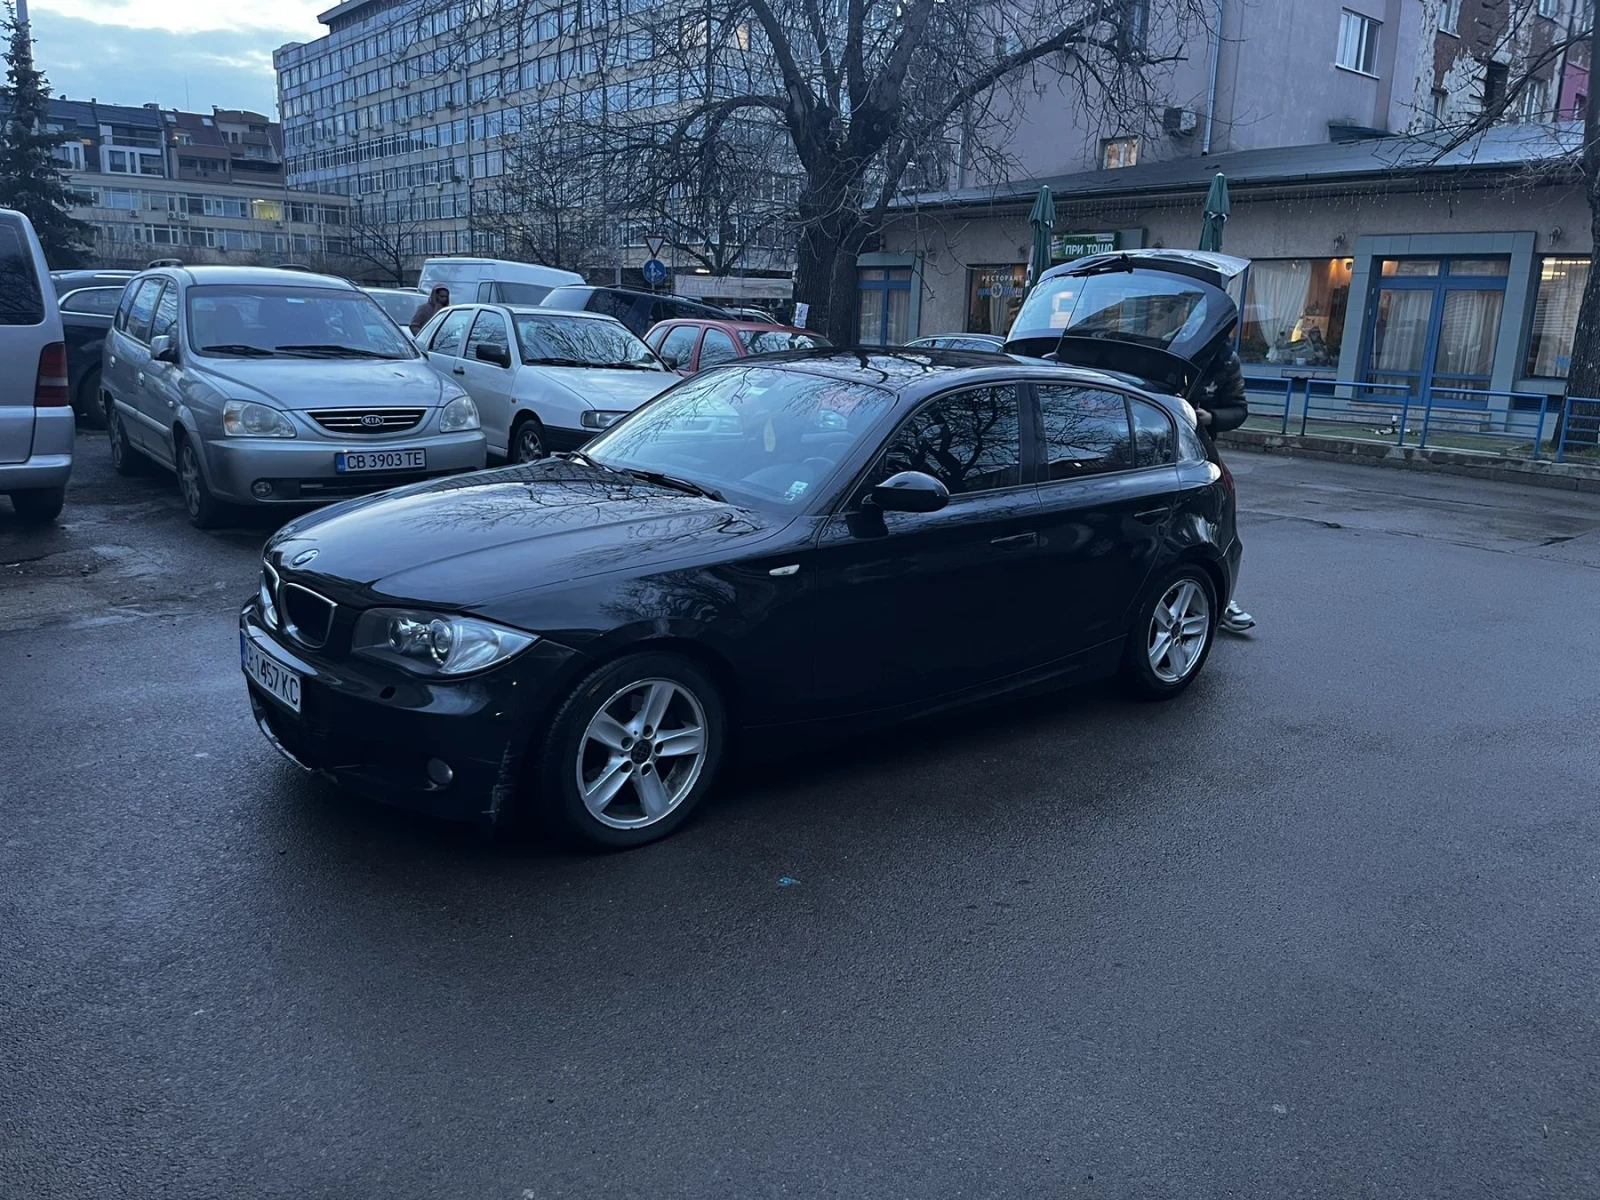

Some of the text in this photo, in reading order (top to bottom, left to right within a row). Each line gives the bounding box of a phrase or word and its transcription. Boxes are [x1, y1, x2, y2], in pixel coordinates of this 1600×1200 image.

[1065, 244, 1083, 255] ПРИ
[1086, 243, 1113, 254] ТОШО
[347, 455, 366, 469] CB
[369, 453, 403, 468] 3903
[405, 452, 423, 466] TE
[255, 654, 279, 691] 1457
[281, 672, 298, 705] KC
